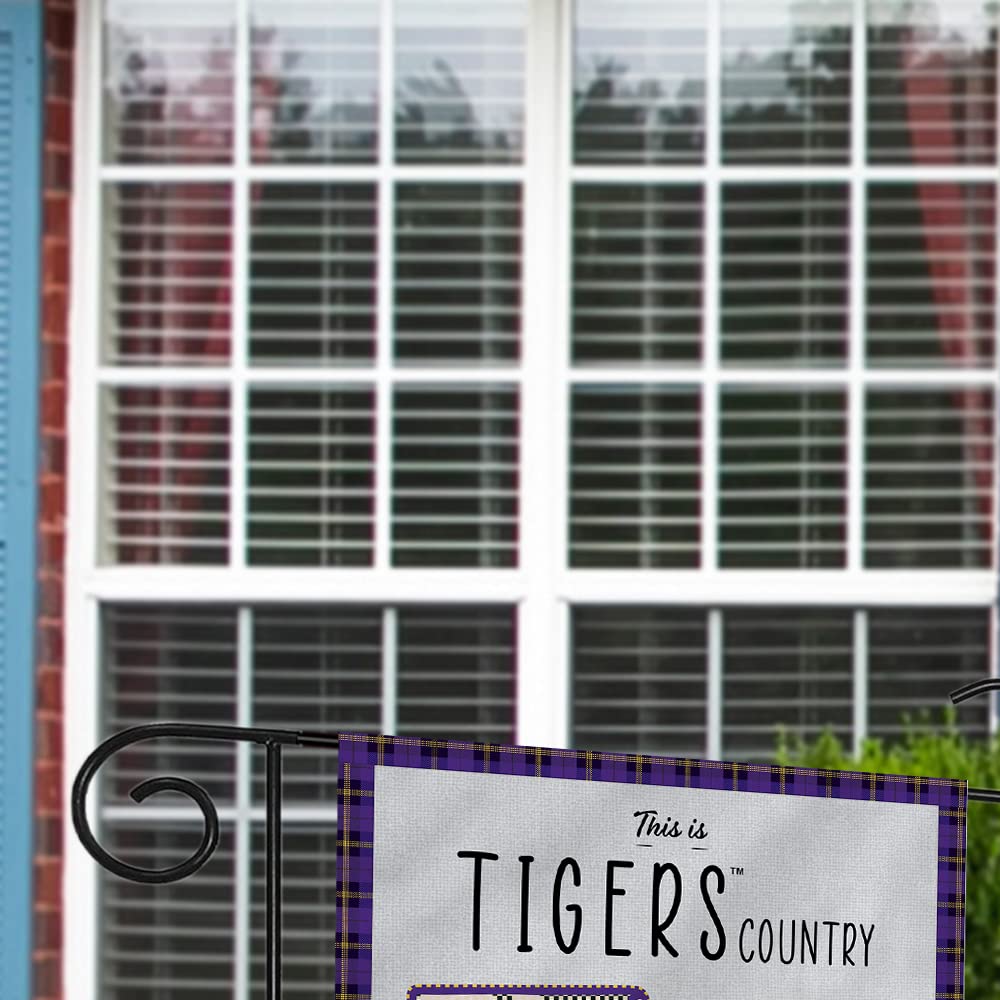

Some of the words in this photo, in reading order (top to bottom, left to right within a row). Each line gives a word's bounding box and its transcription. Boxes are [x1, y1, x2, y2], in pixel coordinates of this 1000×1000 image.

[634, 810, 684, 838] This
[687, 818, 709, 840] is
[738, 917, 876, 968] COUNTRY
